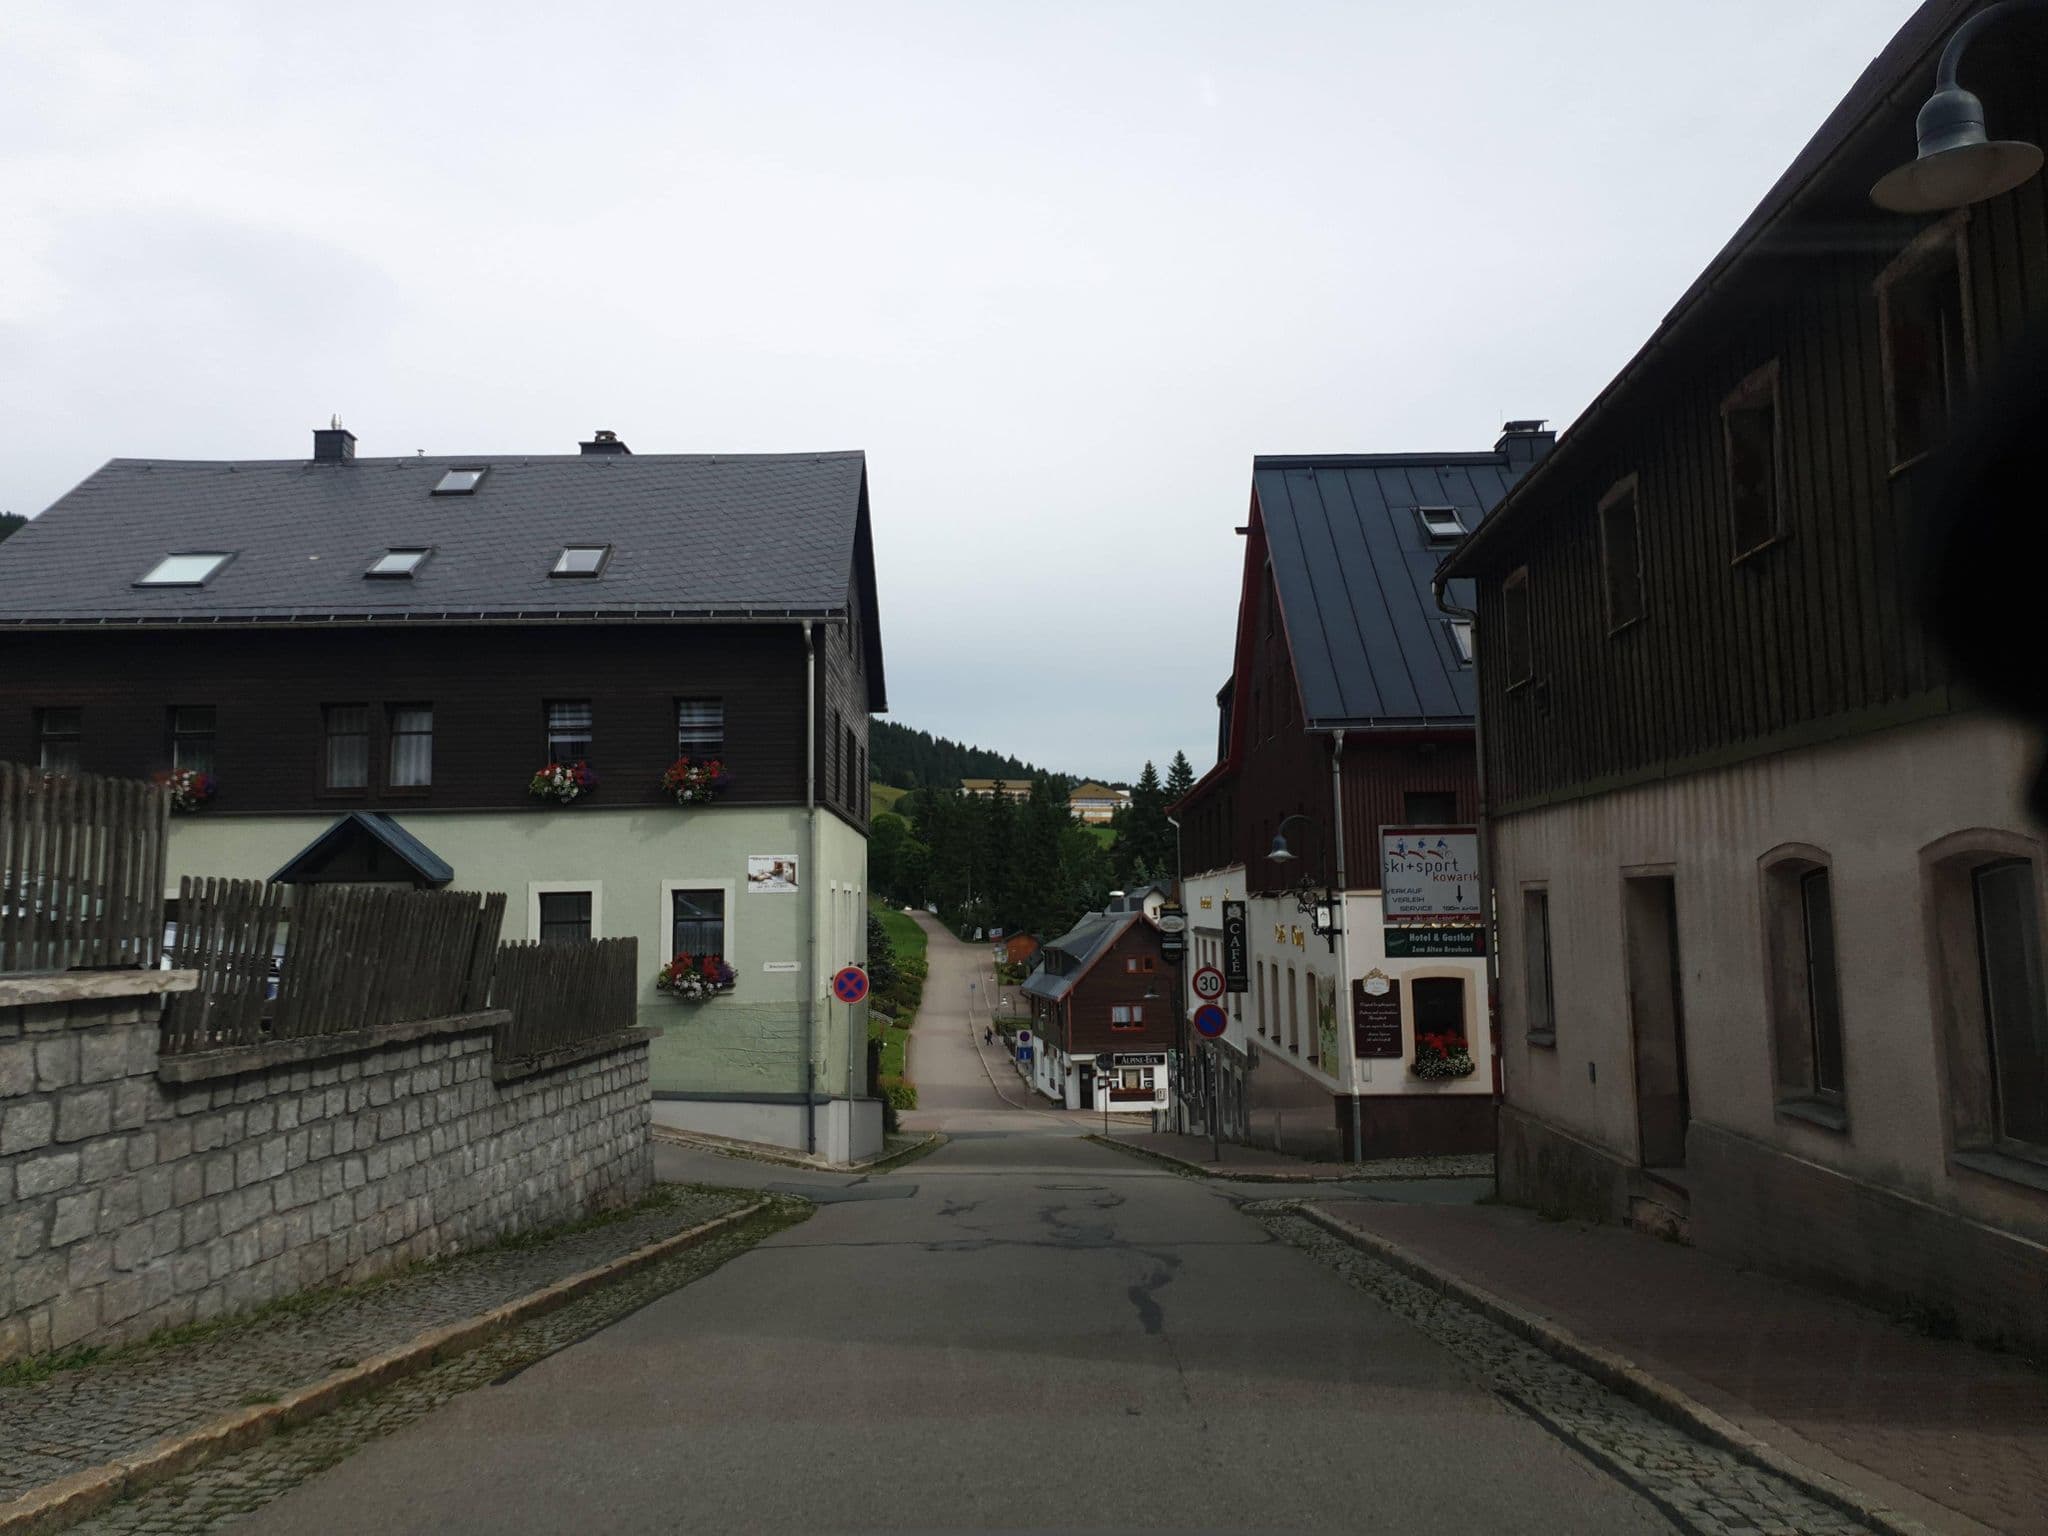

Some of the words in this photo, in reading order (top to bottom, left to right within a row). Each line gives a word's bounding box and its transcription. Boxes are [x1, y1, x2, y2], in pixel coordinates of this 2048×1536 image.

[1384, 858, 1459, 876] ski+sport
[1432, 871, 1480, 882] kowarik
[1409, 933, 1431, 942] Hotel
[1433, 933, 1439, 942] &
[1442, 932, 1474, 942] Gasthof
[1199, 975, 1219, 991] 30
